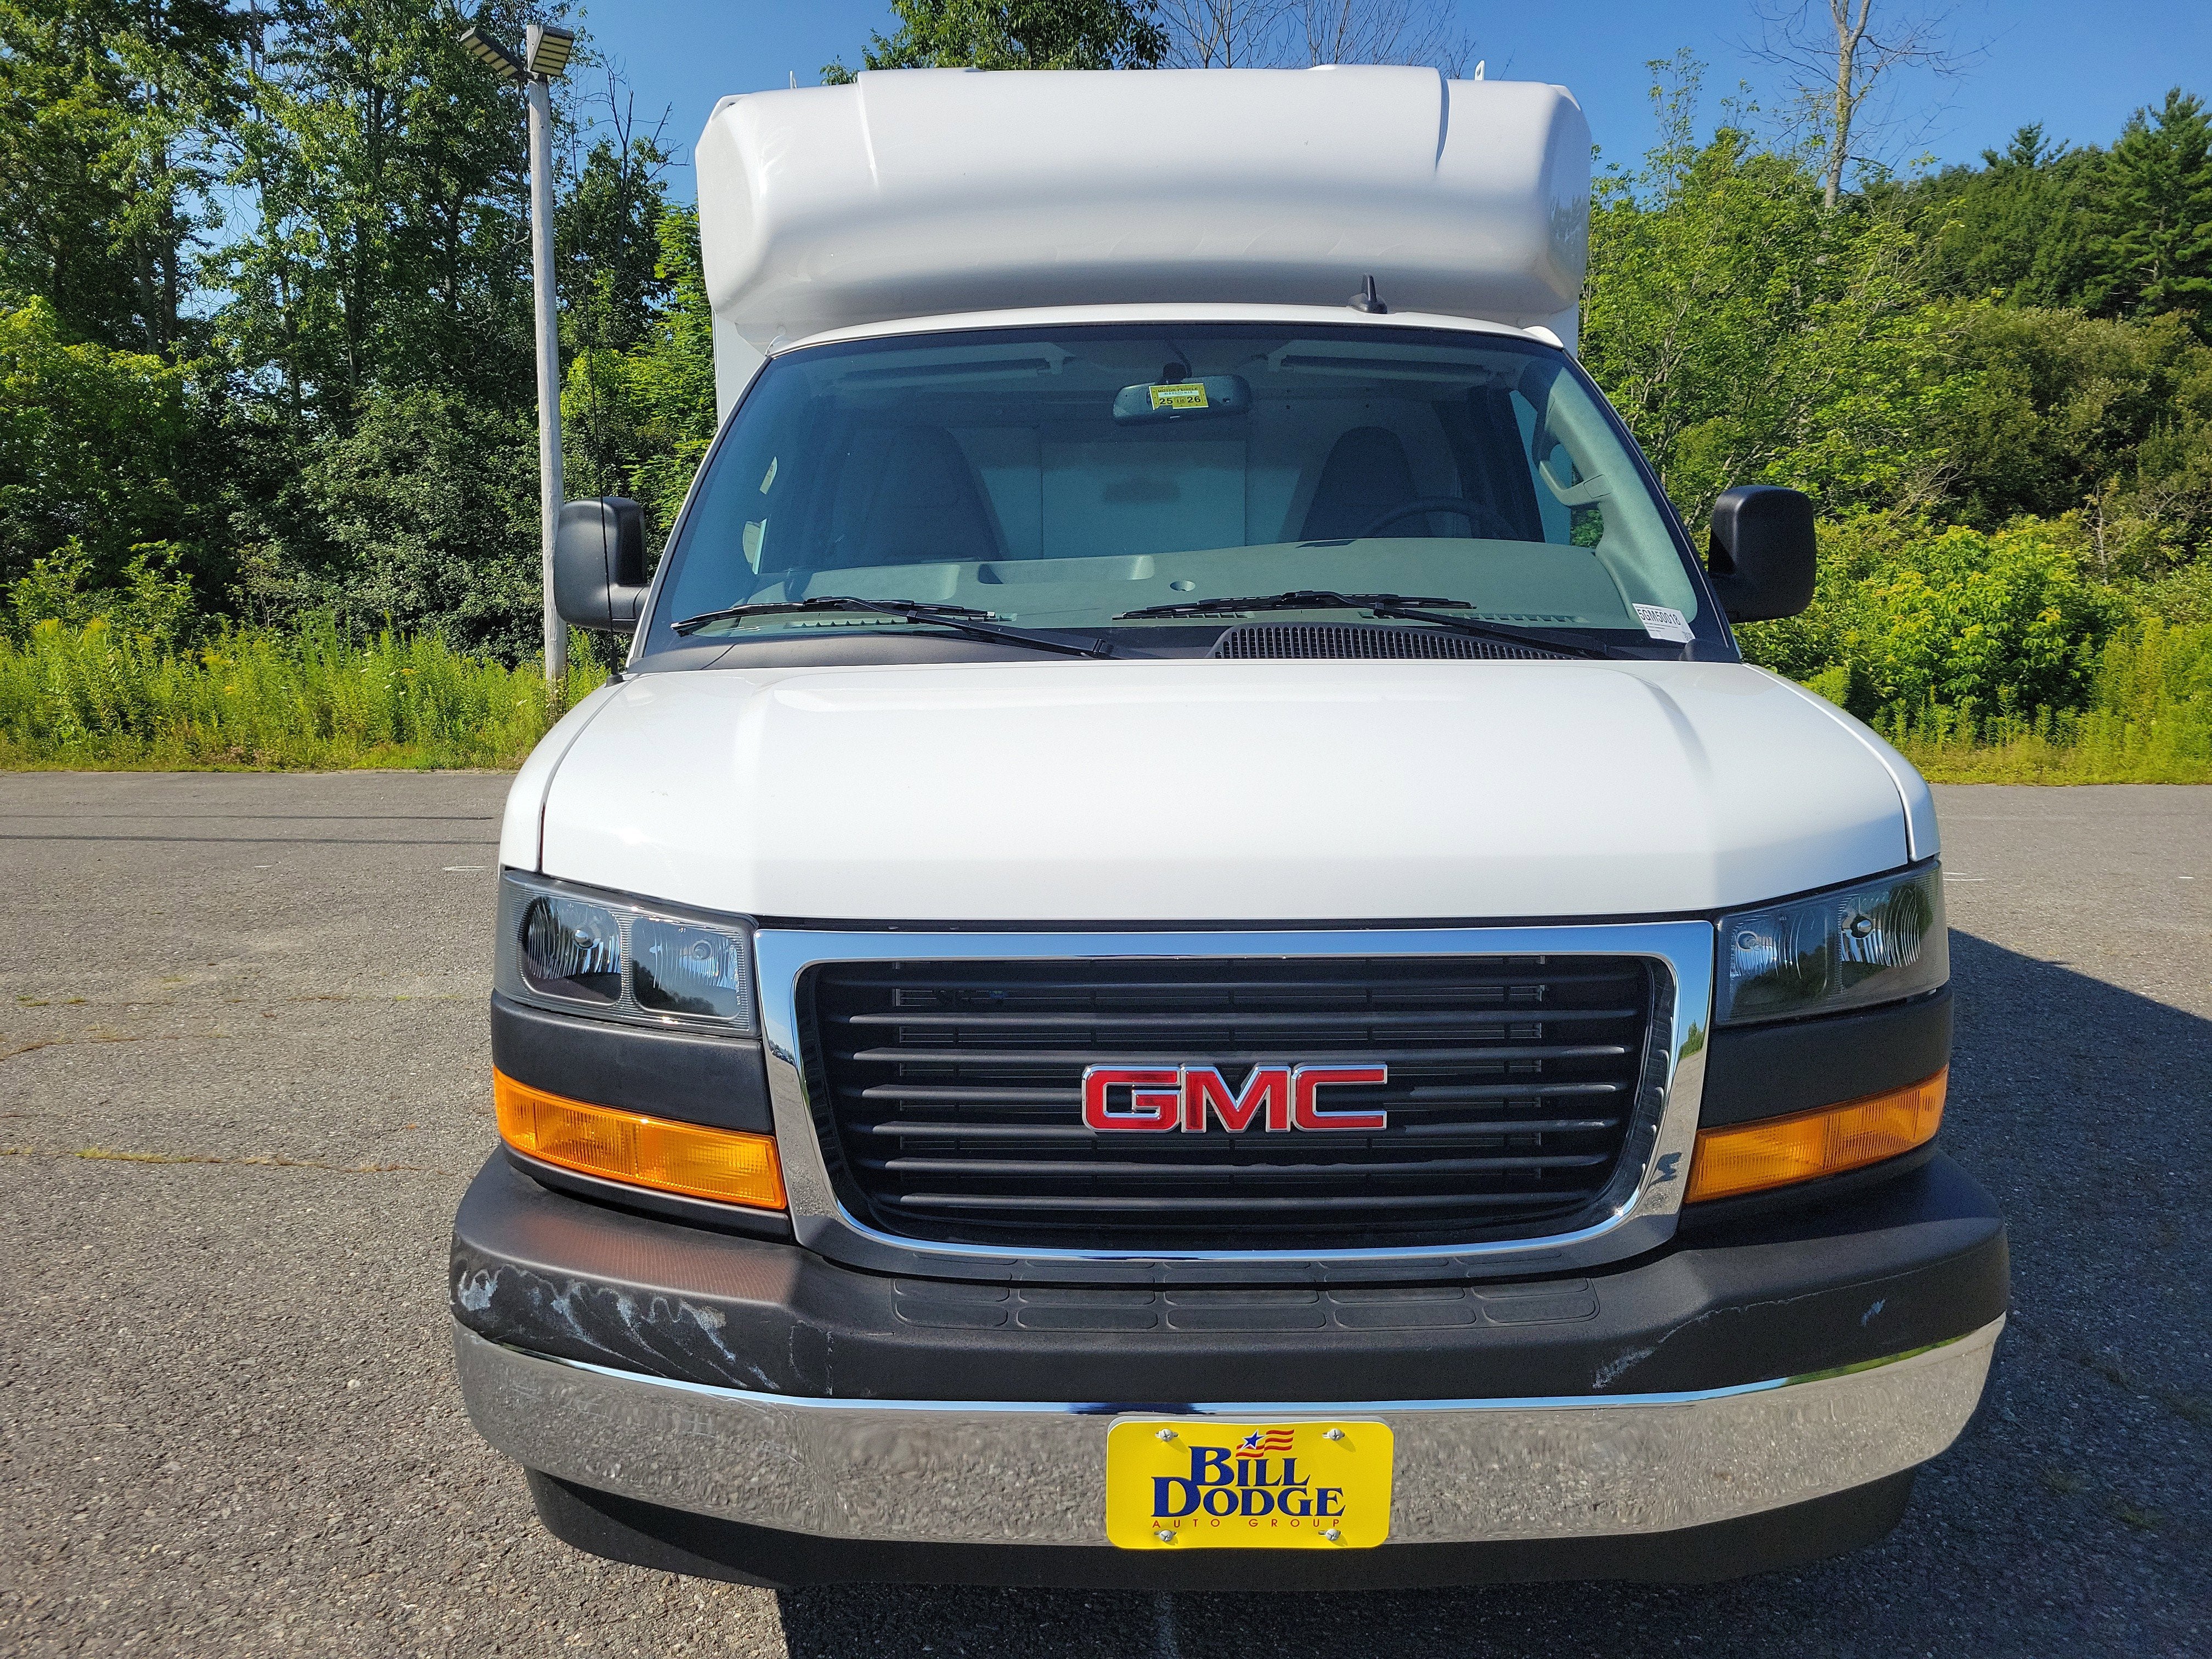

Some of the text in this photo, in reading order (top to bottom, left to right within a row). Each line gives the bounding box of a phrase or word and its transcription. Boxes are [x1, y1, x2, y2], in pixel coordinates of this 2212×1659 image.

[1637, 609, 1681, 625] 5GM50018
[1081, 1063, 1387, 1133] GMC
[1188, 1446, 1310, 1487] BILL
[1150, 1476, 1346, 1517] DODGE
[1152, 1518, 1340, 1528] AUTO GROUP
